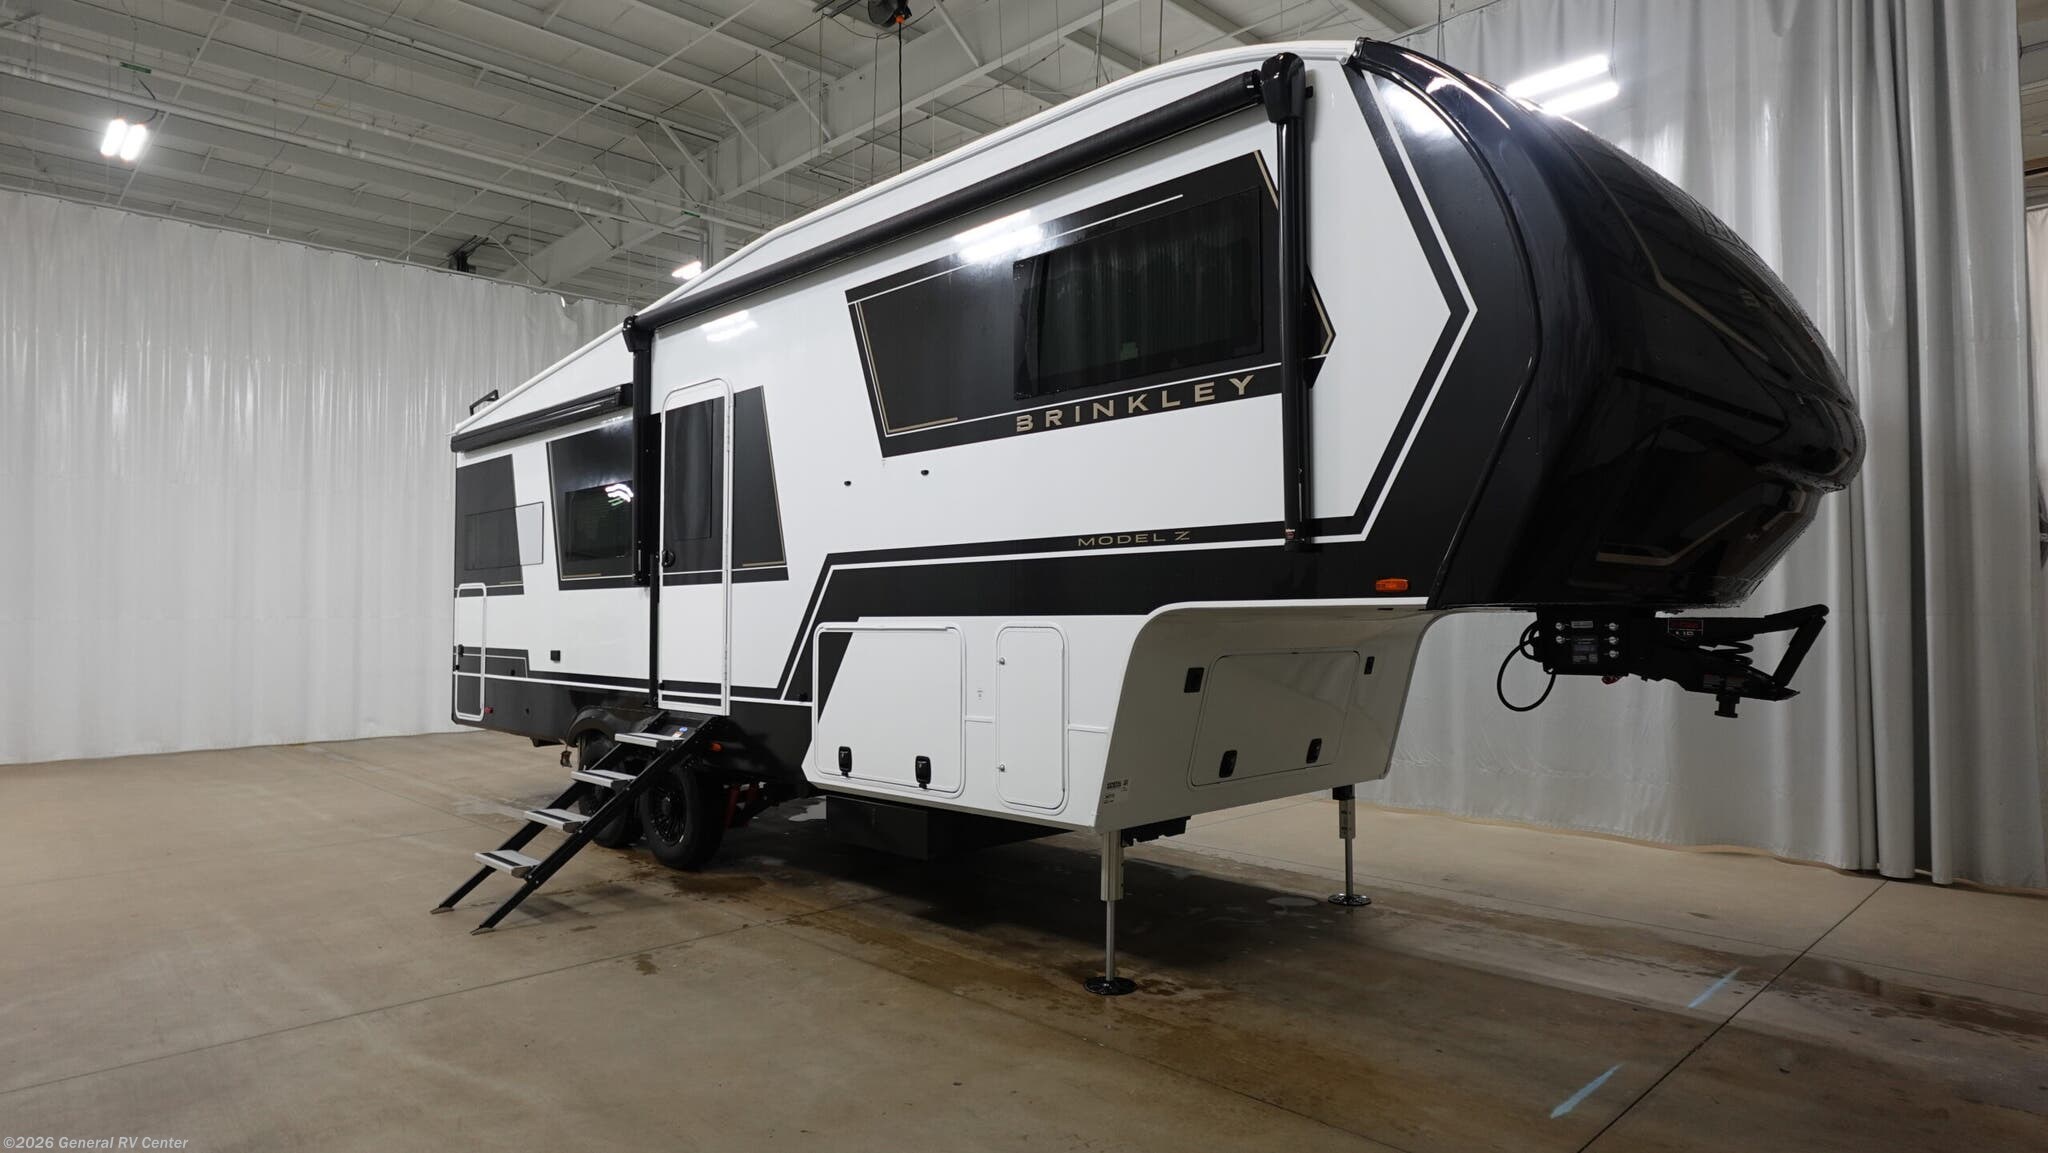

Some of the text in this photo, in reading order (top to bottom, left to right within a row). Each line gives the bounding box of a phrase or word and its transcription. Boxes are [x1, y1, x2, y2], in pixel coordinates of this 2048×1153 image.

[1016, 374, 1255, 432] BRINKLEY
[1077, 530, 1191, 547] MODEL Z
